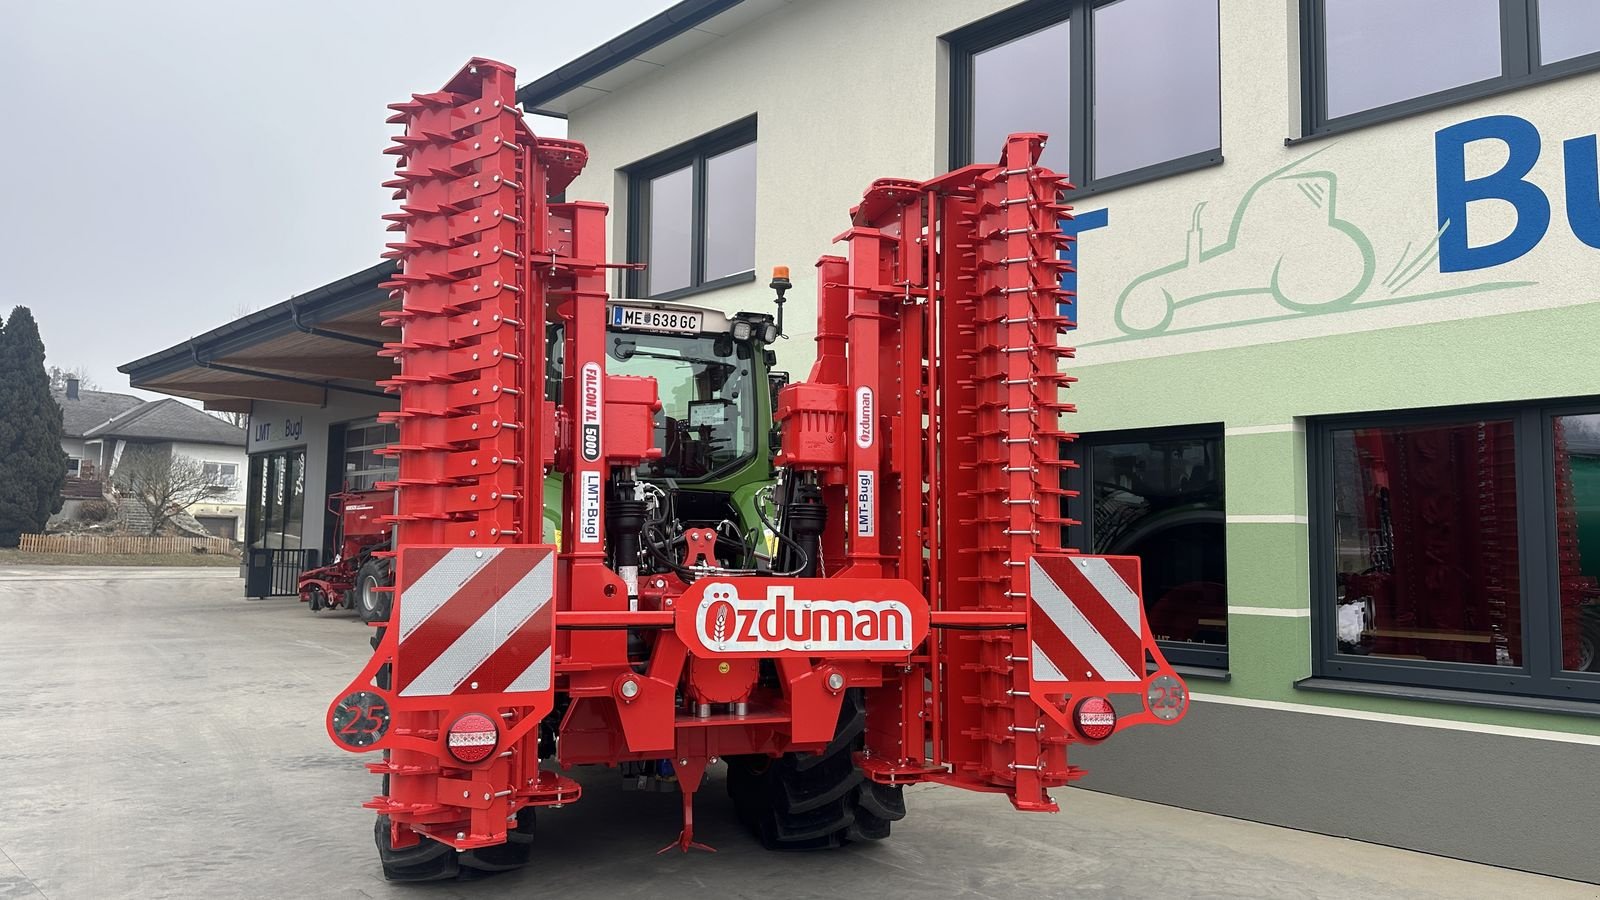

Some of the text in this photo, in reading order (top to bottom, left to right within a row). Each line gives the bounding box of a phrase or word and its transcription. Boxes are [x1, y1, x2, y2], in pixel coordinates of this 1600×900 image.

[625, 310, 642, 325] ME
[653, 313, 677, 328] 638
[680, 316, 696, 329] GC
[256, 415, 303, 442] LMT Bugl
[585, 368, 597, 456] FALCON XL 5000
[859, 392, 870, 443] Özduman
[585, 475, 599, 538] LMT-Bugl
[859, 474, 870, 533] LMT-Bugl
[704, 592, 904, 642] Özduman
[340, 705, 385, 734] 25
[1153, 686, 1181, 710] 25
